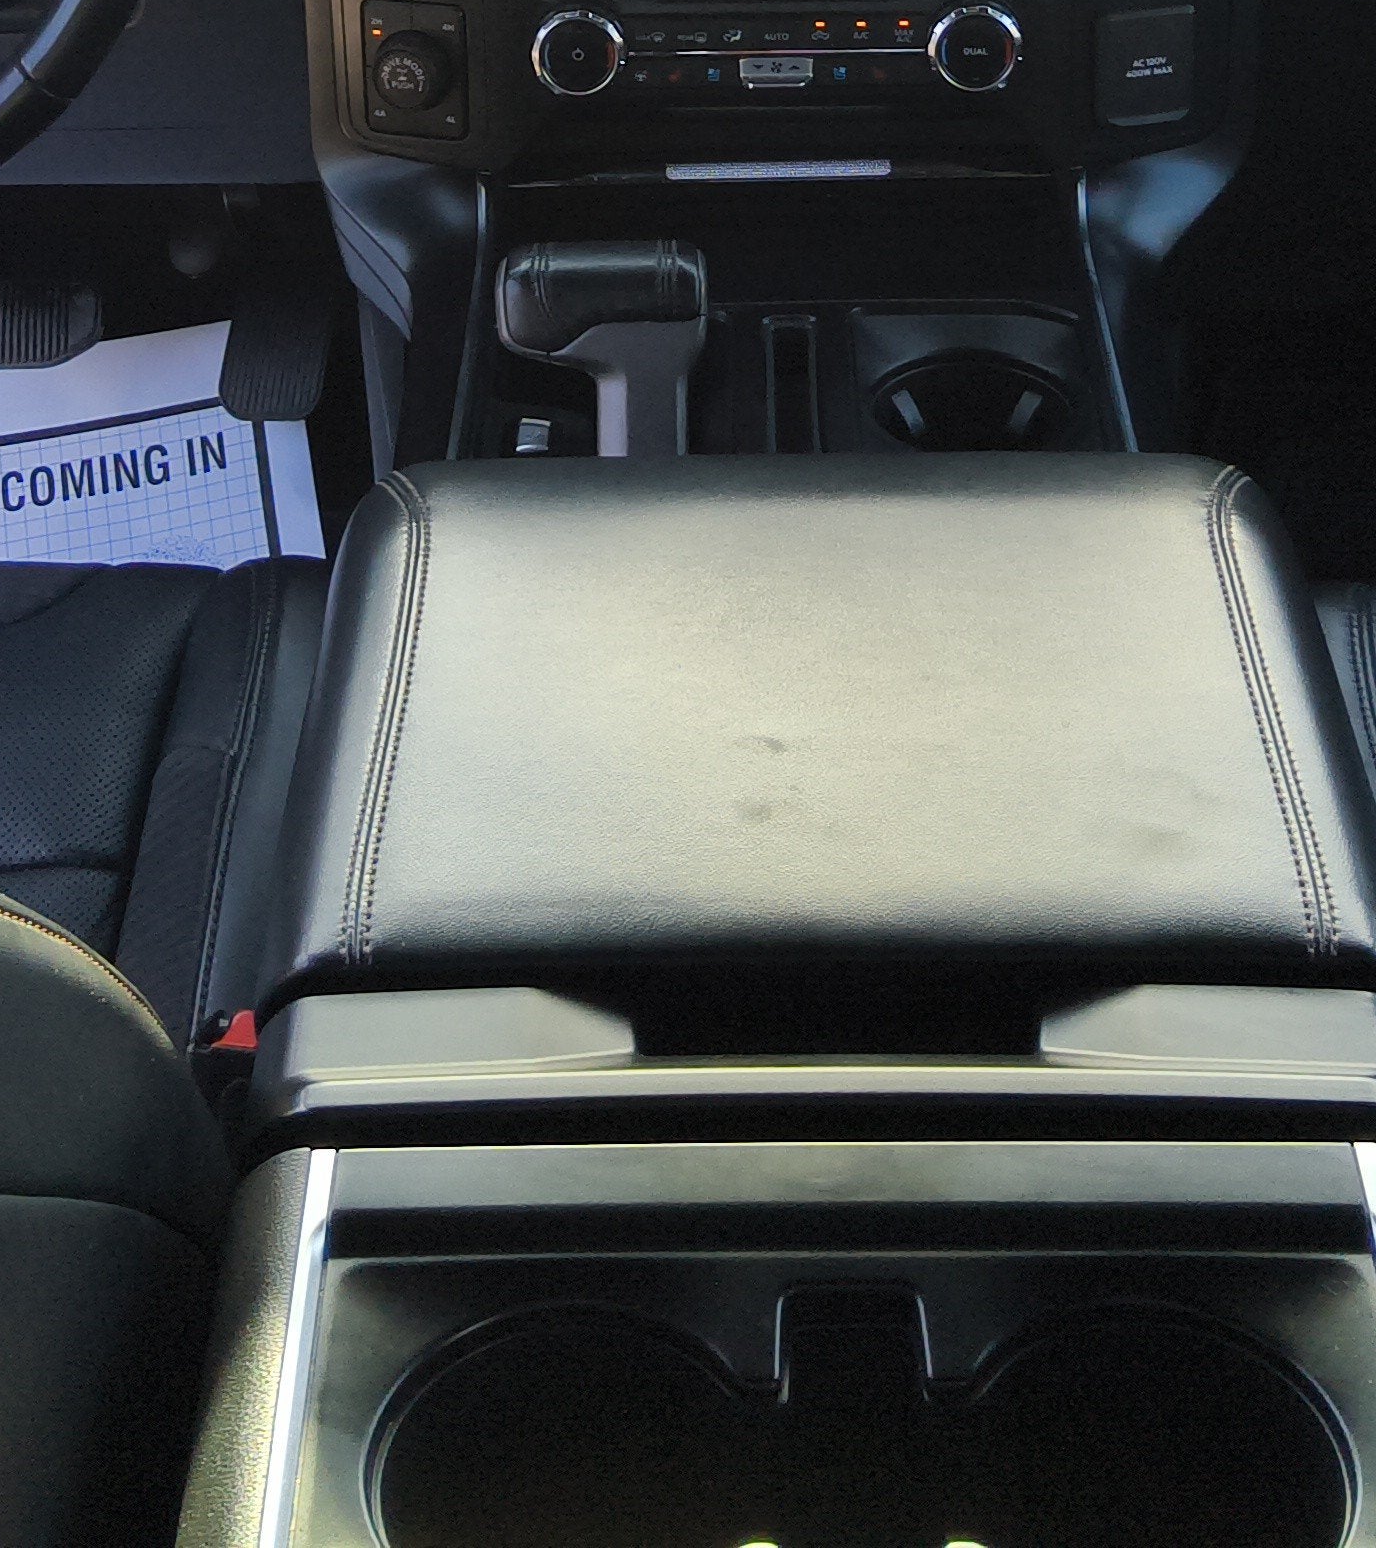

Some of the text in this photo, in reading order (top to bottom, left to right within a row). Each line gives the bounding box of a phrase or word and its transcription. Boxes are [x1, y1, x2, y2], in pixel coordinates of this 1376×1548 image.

[764, 32, 790, 41] AUTO
[963, 47, 989, 56] DUAL
[0, 442, 170, 513] COMING
[187, 430, 228, 477] IN
